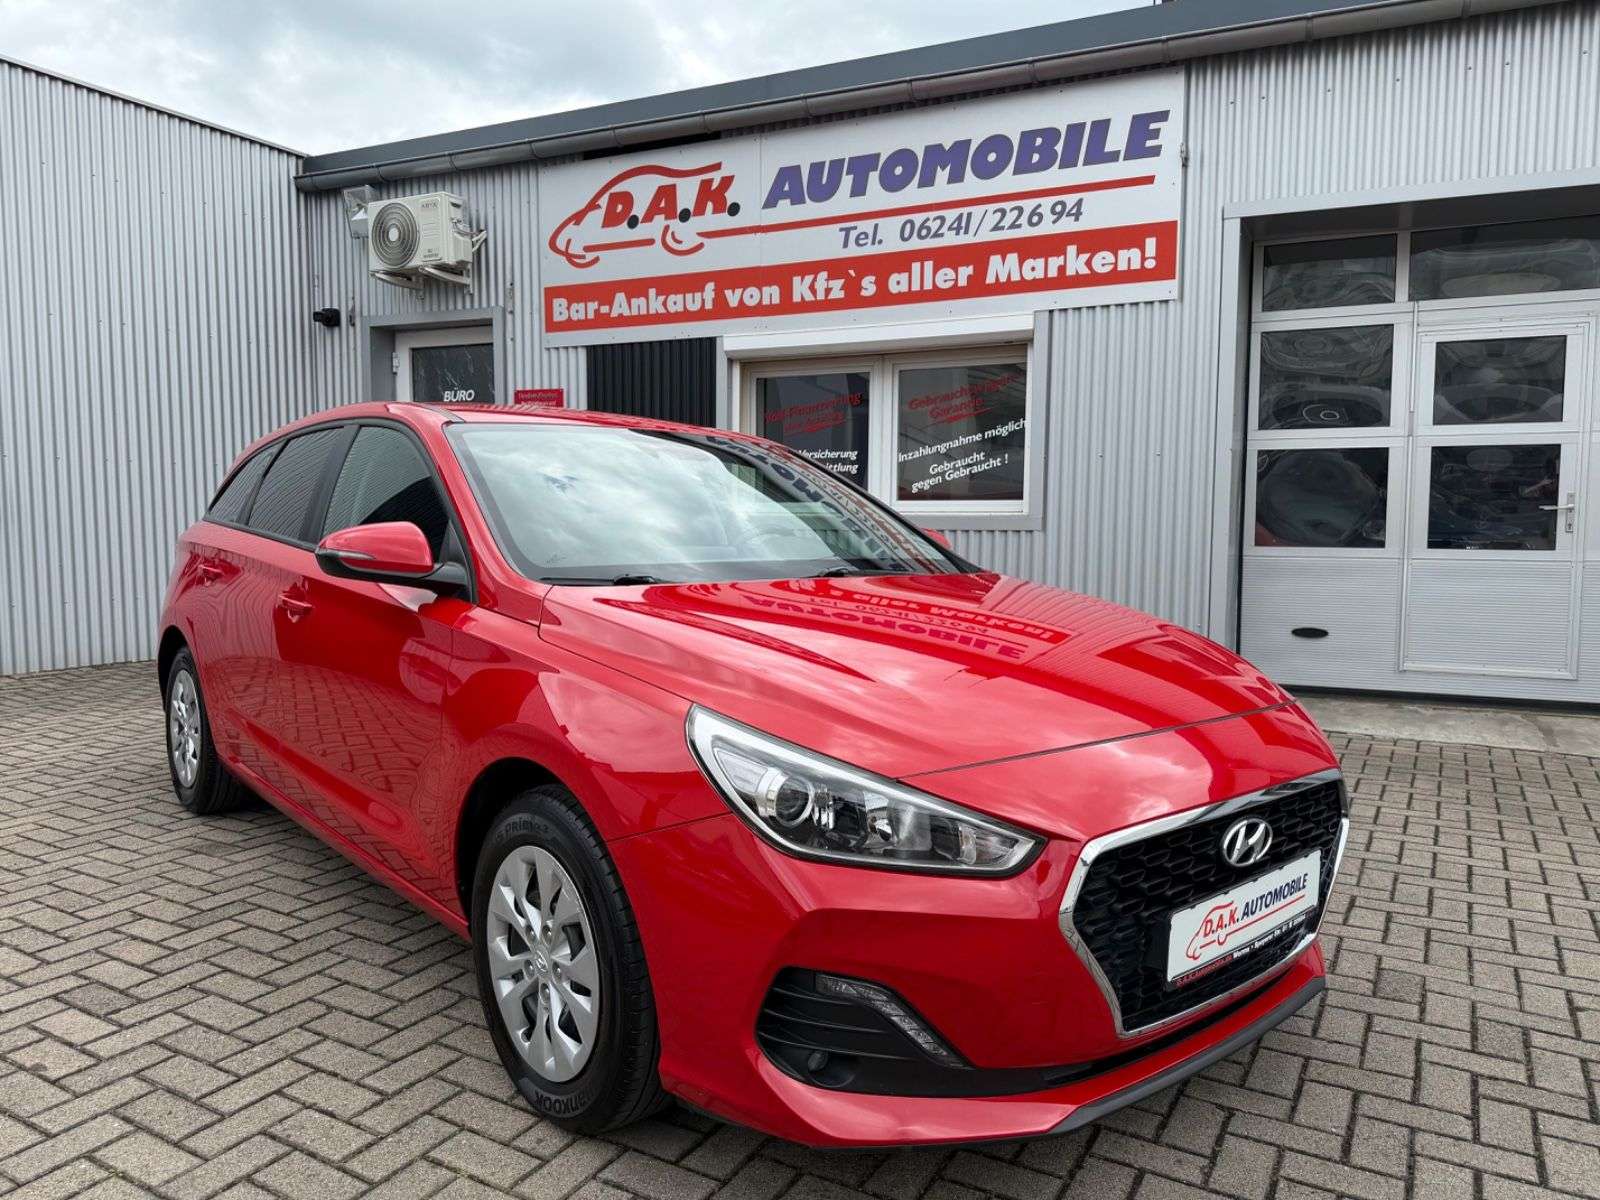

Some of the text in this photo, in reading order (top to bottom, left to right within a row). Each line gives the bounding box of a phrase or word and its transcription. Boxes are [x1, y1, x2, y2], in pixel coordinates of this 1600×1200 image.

[602, 110, 1170, 229] D.A.K. AUTOMOBILE
[839, 222, 883, 248] Tel.
[553, 282, 715, 322] Bar-Ankauf
[725, 284, 780, 307] von
[888, 261, 973, 294] aller
[986, 237, 1157, 284] Marken!
[444, 387, 475, 402] BÜRO
[899, 435, 982, 462] Inzahlungnahme
[929, 452, 985, 474] Gebraucht
[912, 475, 942, 493] gegen
[945, 458, 1001, 480] Gebraucht
[1203, 906, 1239, 937] D.A.K.
[1241, 873, 1308, 920] AUTOMOBILE
